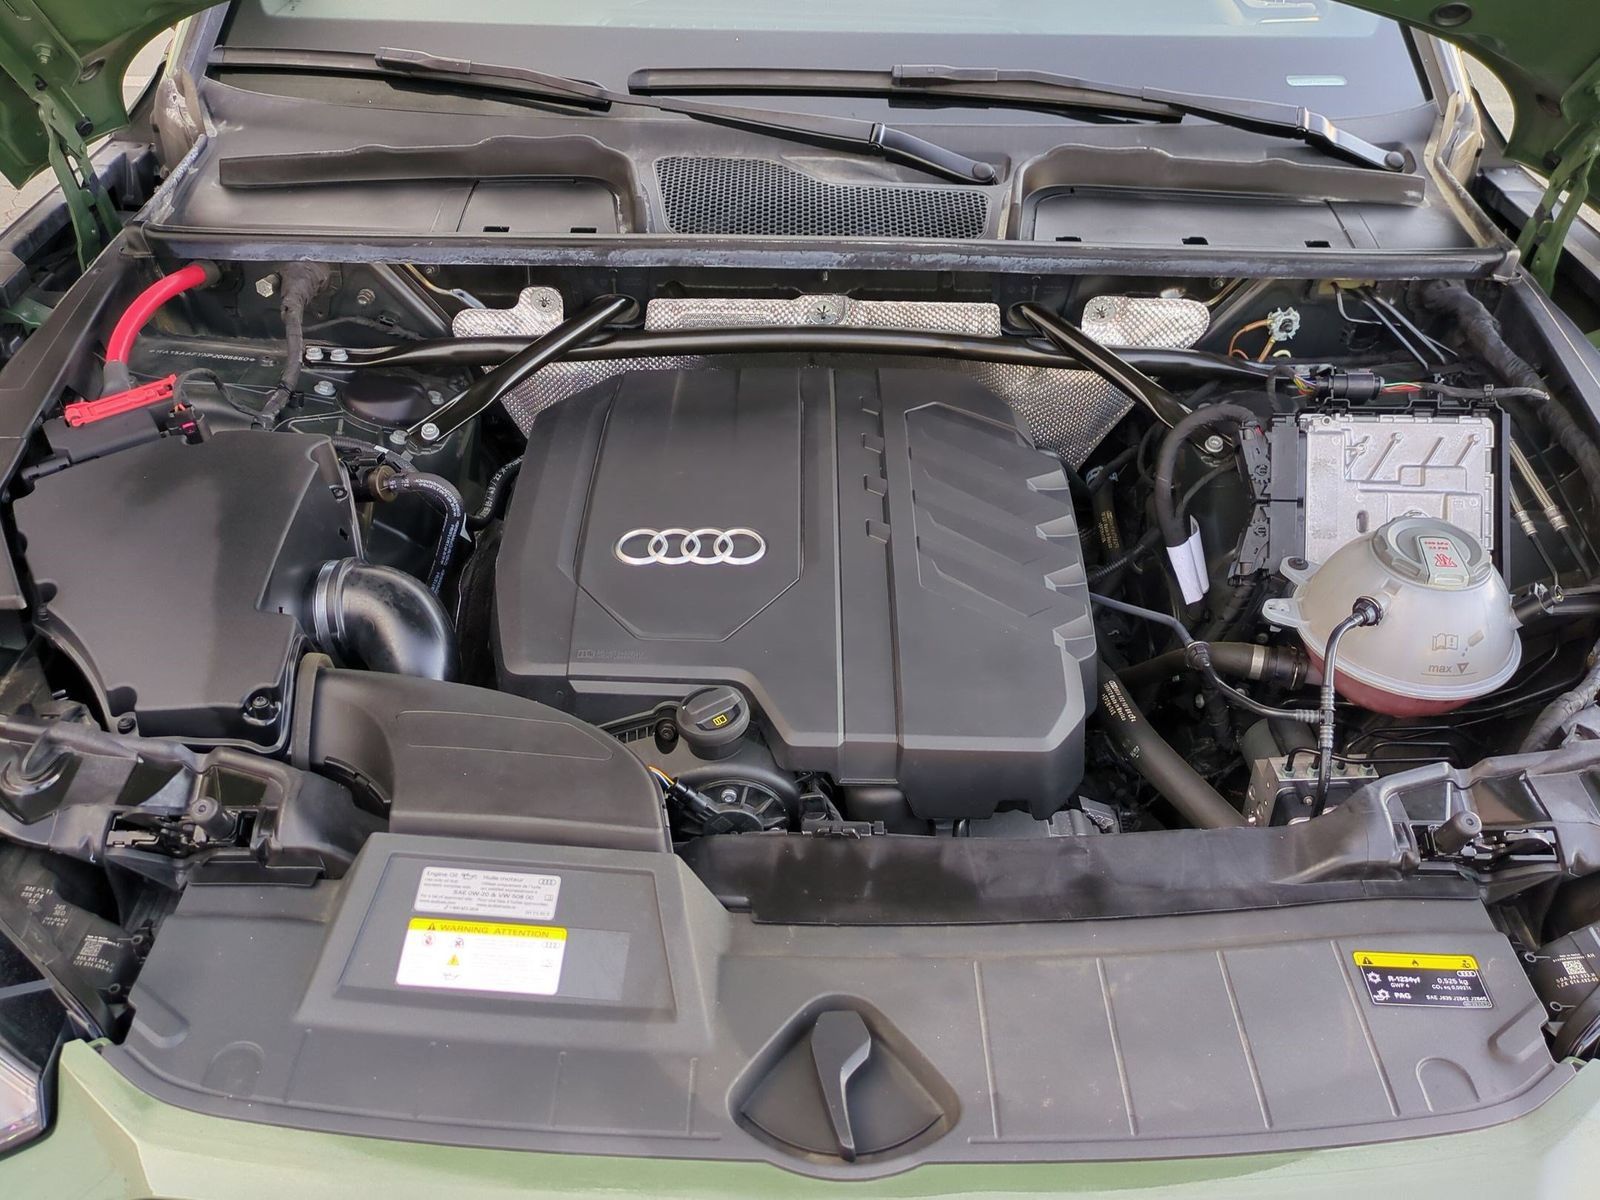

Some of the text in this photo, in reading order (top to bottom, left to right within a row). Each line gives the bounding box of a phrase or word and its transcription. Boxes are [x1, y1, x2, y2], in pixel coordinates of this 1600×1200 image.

[1428, 664, 1452, 673] max
[439, 924, 550, 938] WARNING ATTENTION
[1393, 992, 1412, 1000] PAG
